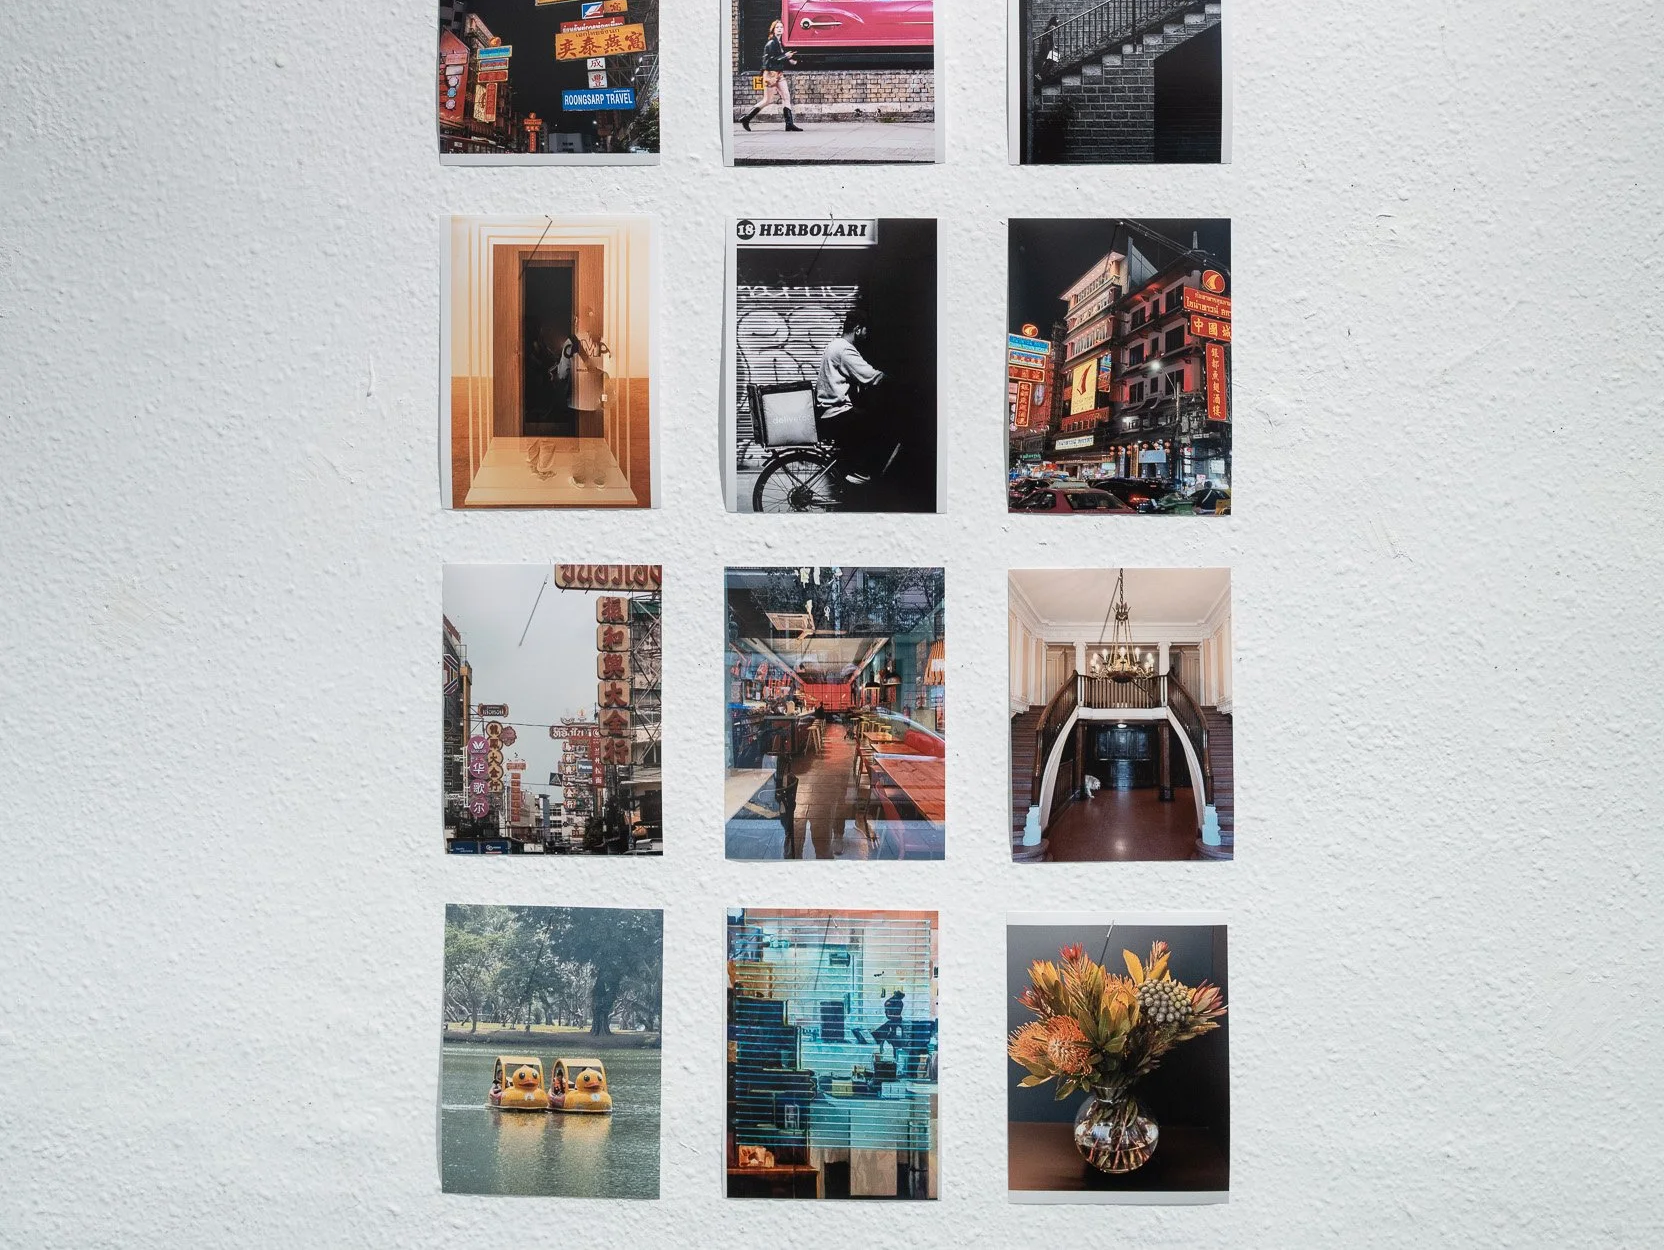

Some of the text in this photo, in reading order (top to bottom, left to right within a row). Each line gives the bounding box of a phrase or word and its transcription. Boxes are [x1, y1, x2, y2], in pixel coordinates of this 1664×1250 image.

[564, 92, 633, 106] ROONGSARP TRAVEL
[737, 223, 868, 237] 18 HERBOLARI
